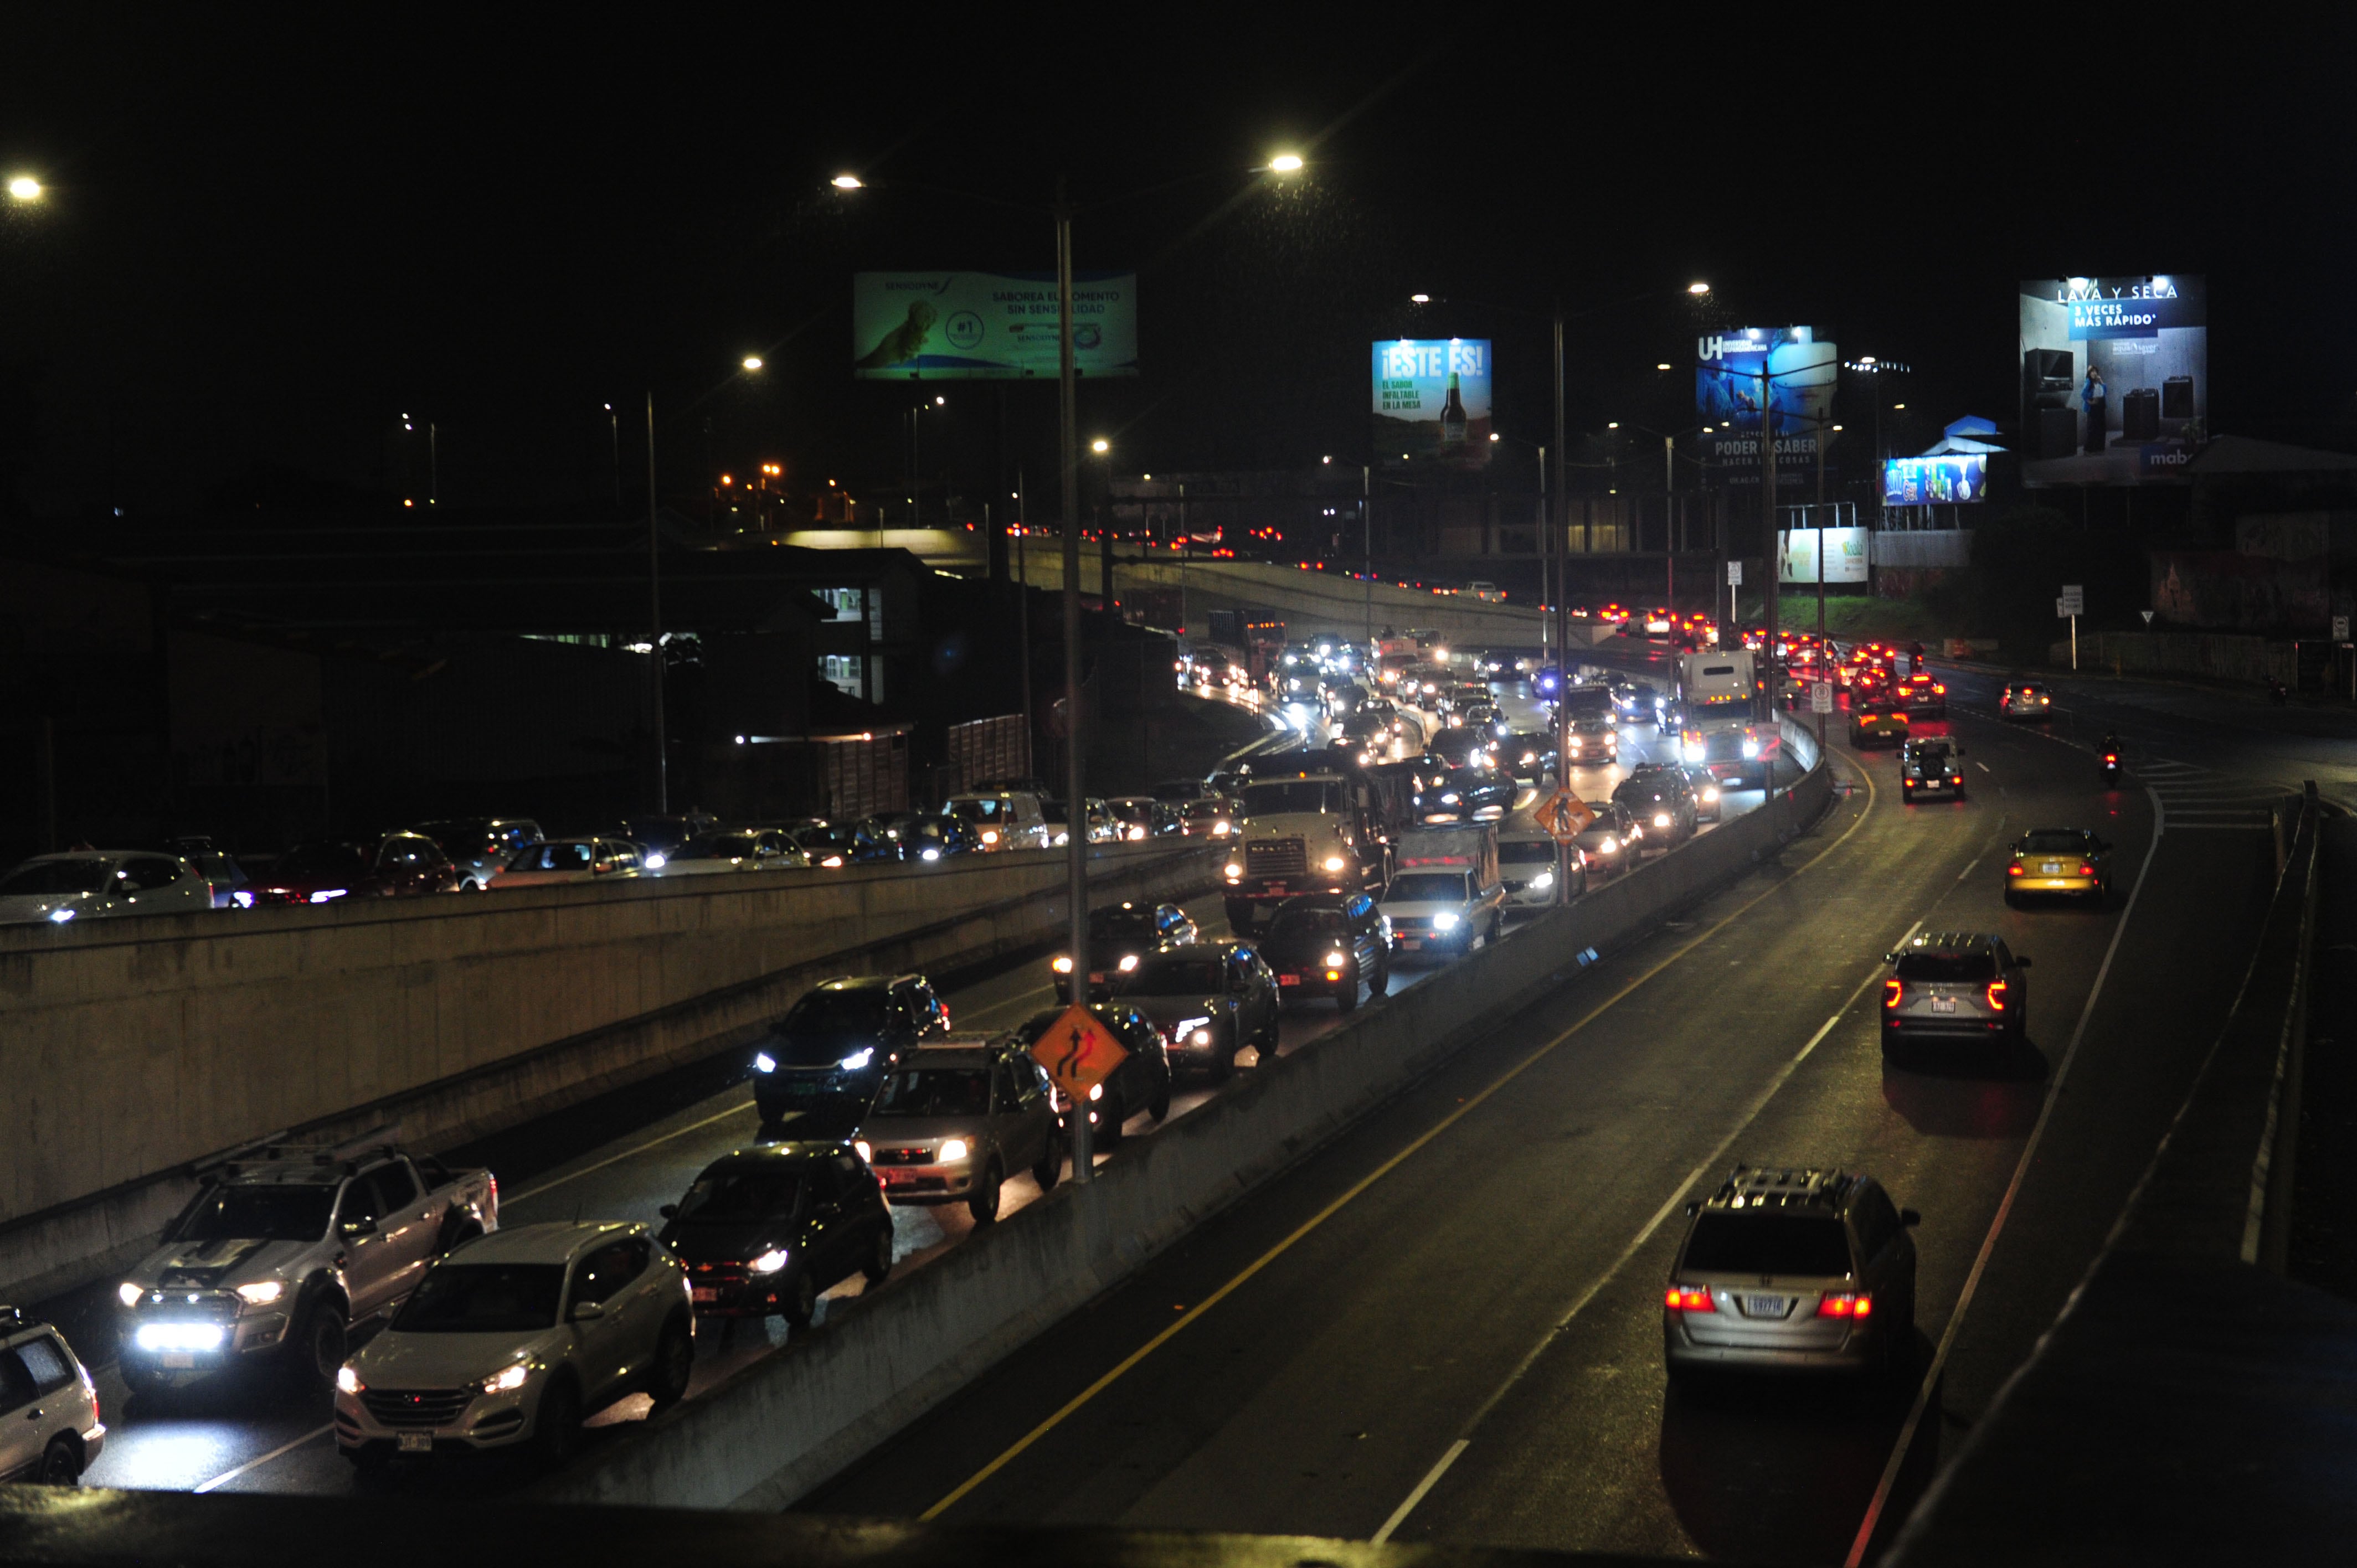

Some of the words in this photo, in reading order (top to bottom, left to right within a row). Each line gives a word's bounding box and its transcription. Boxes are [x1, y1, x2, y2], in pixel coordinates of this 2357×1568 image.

[992, 292, 1044, 302] SABOREA
[1048, 292, 1059, 302] EL
[2057, 287, 2102, 303] LAVA
[2112, 286, 2122, 300] Y
[2132, 283, 2178, 300] SECA
[1007, 305, 1025, 314] SIN
[2075, 306, 2081, 316] 3
[2086, 304, 2122, 314] VECES
[1699, 336, 1723, 360] UH
[1382, 347, 1442, 380] ¡ESTE
[1449, 345, 1483, 376] ES!
[1382, 380, 1388, 389] EL
[1392, 380, 1412, 389] SABOR
[1382, 390, 1419, 399] INFALTABLE
[1383, 401, 1391, 410] EN
[1392, 401, 1400, 409] LA
[1402, 400, 1421, 409] MESA
[1716, 440, 1757, 456] PODER
[1774, 439, 1817, 453] SABER
[1779, 455, 1810, 465] COSAS
